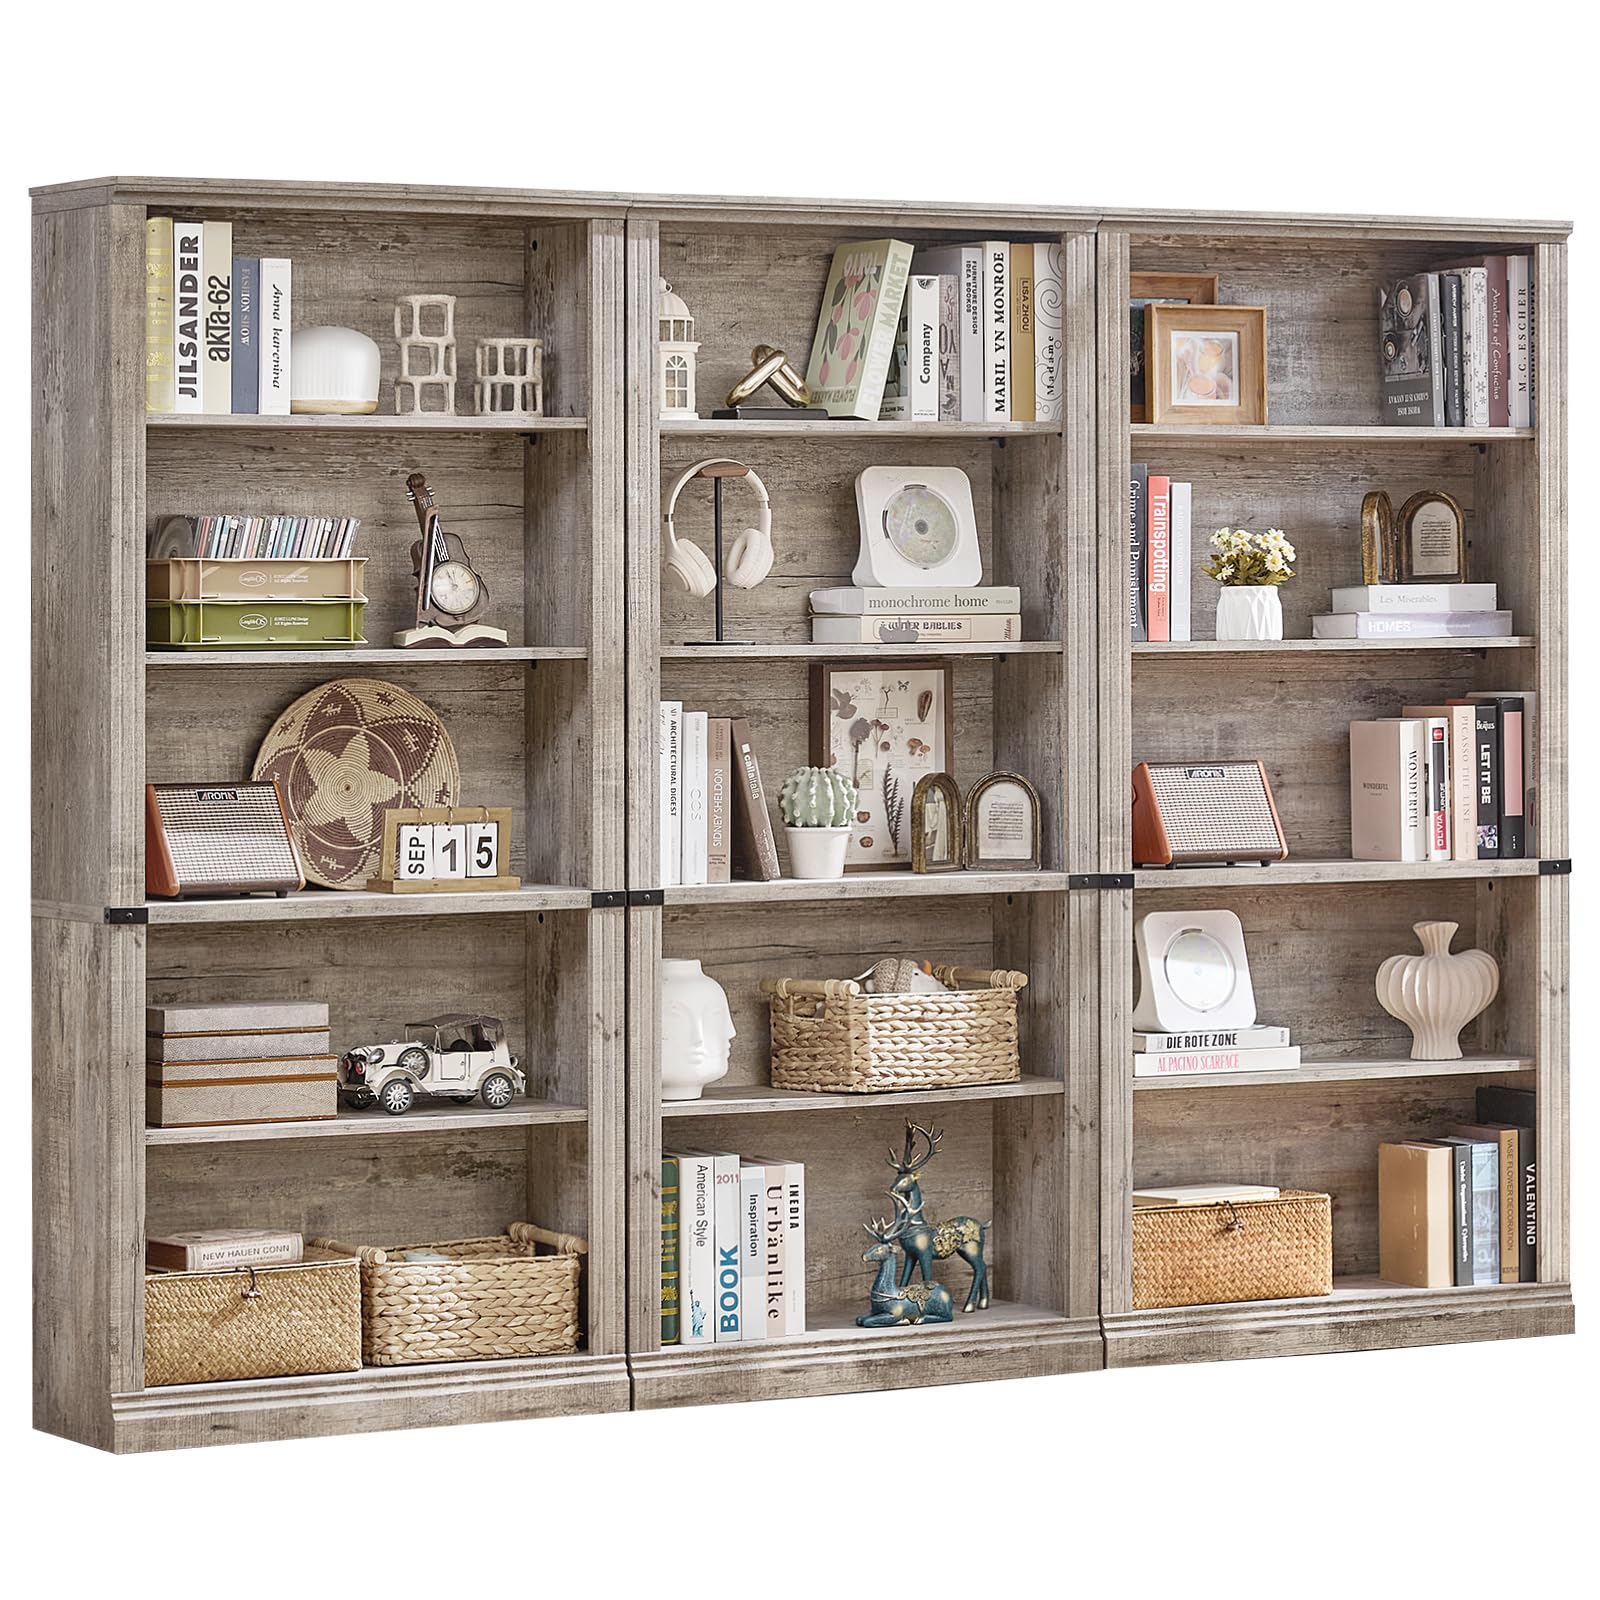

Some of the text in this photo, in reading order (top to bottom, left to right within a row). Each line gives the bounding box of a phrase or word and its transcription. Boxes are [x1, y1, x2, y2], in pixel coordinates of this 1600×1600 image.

[240, 268, 251, 346] FASHION SHOW
[881, 253, 909, 329] MARKET
[993, 252, 1005, 324] MONROE
[1022, 280, 1030, 331] LISA ZHOU
[178, 235, 199, 398] JILSANDER
[272, 284, 283, 389] Anna karenina
[1491, 287, 1502, 400] Analects of Confucius
[1518, 288, 1527, 351] ESCHER
[920, 323, 933, 384] Company
[1046, 335, 1055, 396] Madame
[869, 594, 989, 609] monochrome home
[1368, 621, 1411, 633] HOMES
[669, 720, 677, 787] ARCHITECTURAL
[1461, 715, 1469, 763] PICASSO
[713, 768, 723, 813] SHELDON
[1408, 749, 1418, 831] WONDERFUL
[1462, 766, 1470, 792] THE
[1480, 744, 1491, 804] LET IT BE
[690, 788, 702, 821] COS
[712, 814, 723, 847] SIDNEY
[1436, 814, 1444, 847] OLIVIA
[1463, 796, 1471, 825] LINE
[408, 837, 426, 875] SEP
[1166, 1036, 1182, 1049] DIE
[1184, 1035, 1209, 1048] ROTE
[1212, 1033, 1238, 1047] ZONE
[1168, 1055, 1199, 1072] PACINO
[1200, 1053, 1239, 1071] SCARFACE
[693, 1164, 708, 1247] American Style
[716, 1174, 739, 1185] 2011
[789, 1184, 800, 1229] INEDIA
[1525, 1163, 1536, 1246] VALENTINO
[202, 1252, 225, 1261] NEW
[262, 1245, 290, 1255] CONN
[749, 1194, 759, 1257] Inspiration
[720, 1245, 739, 1333] BOOK
